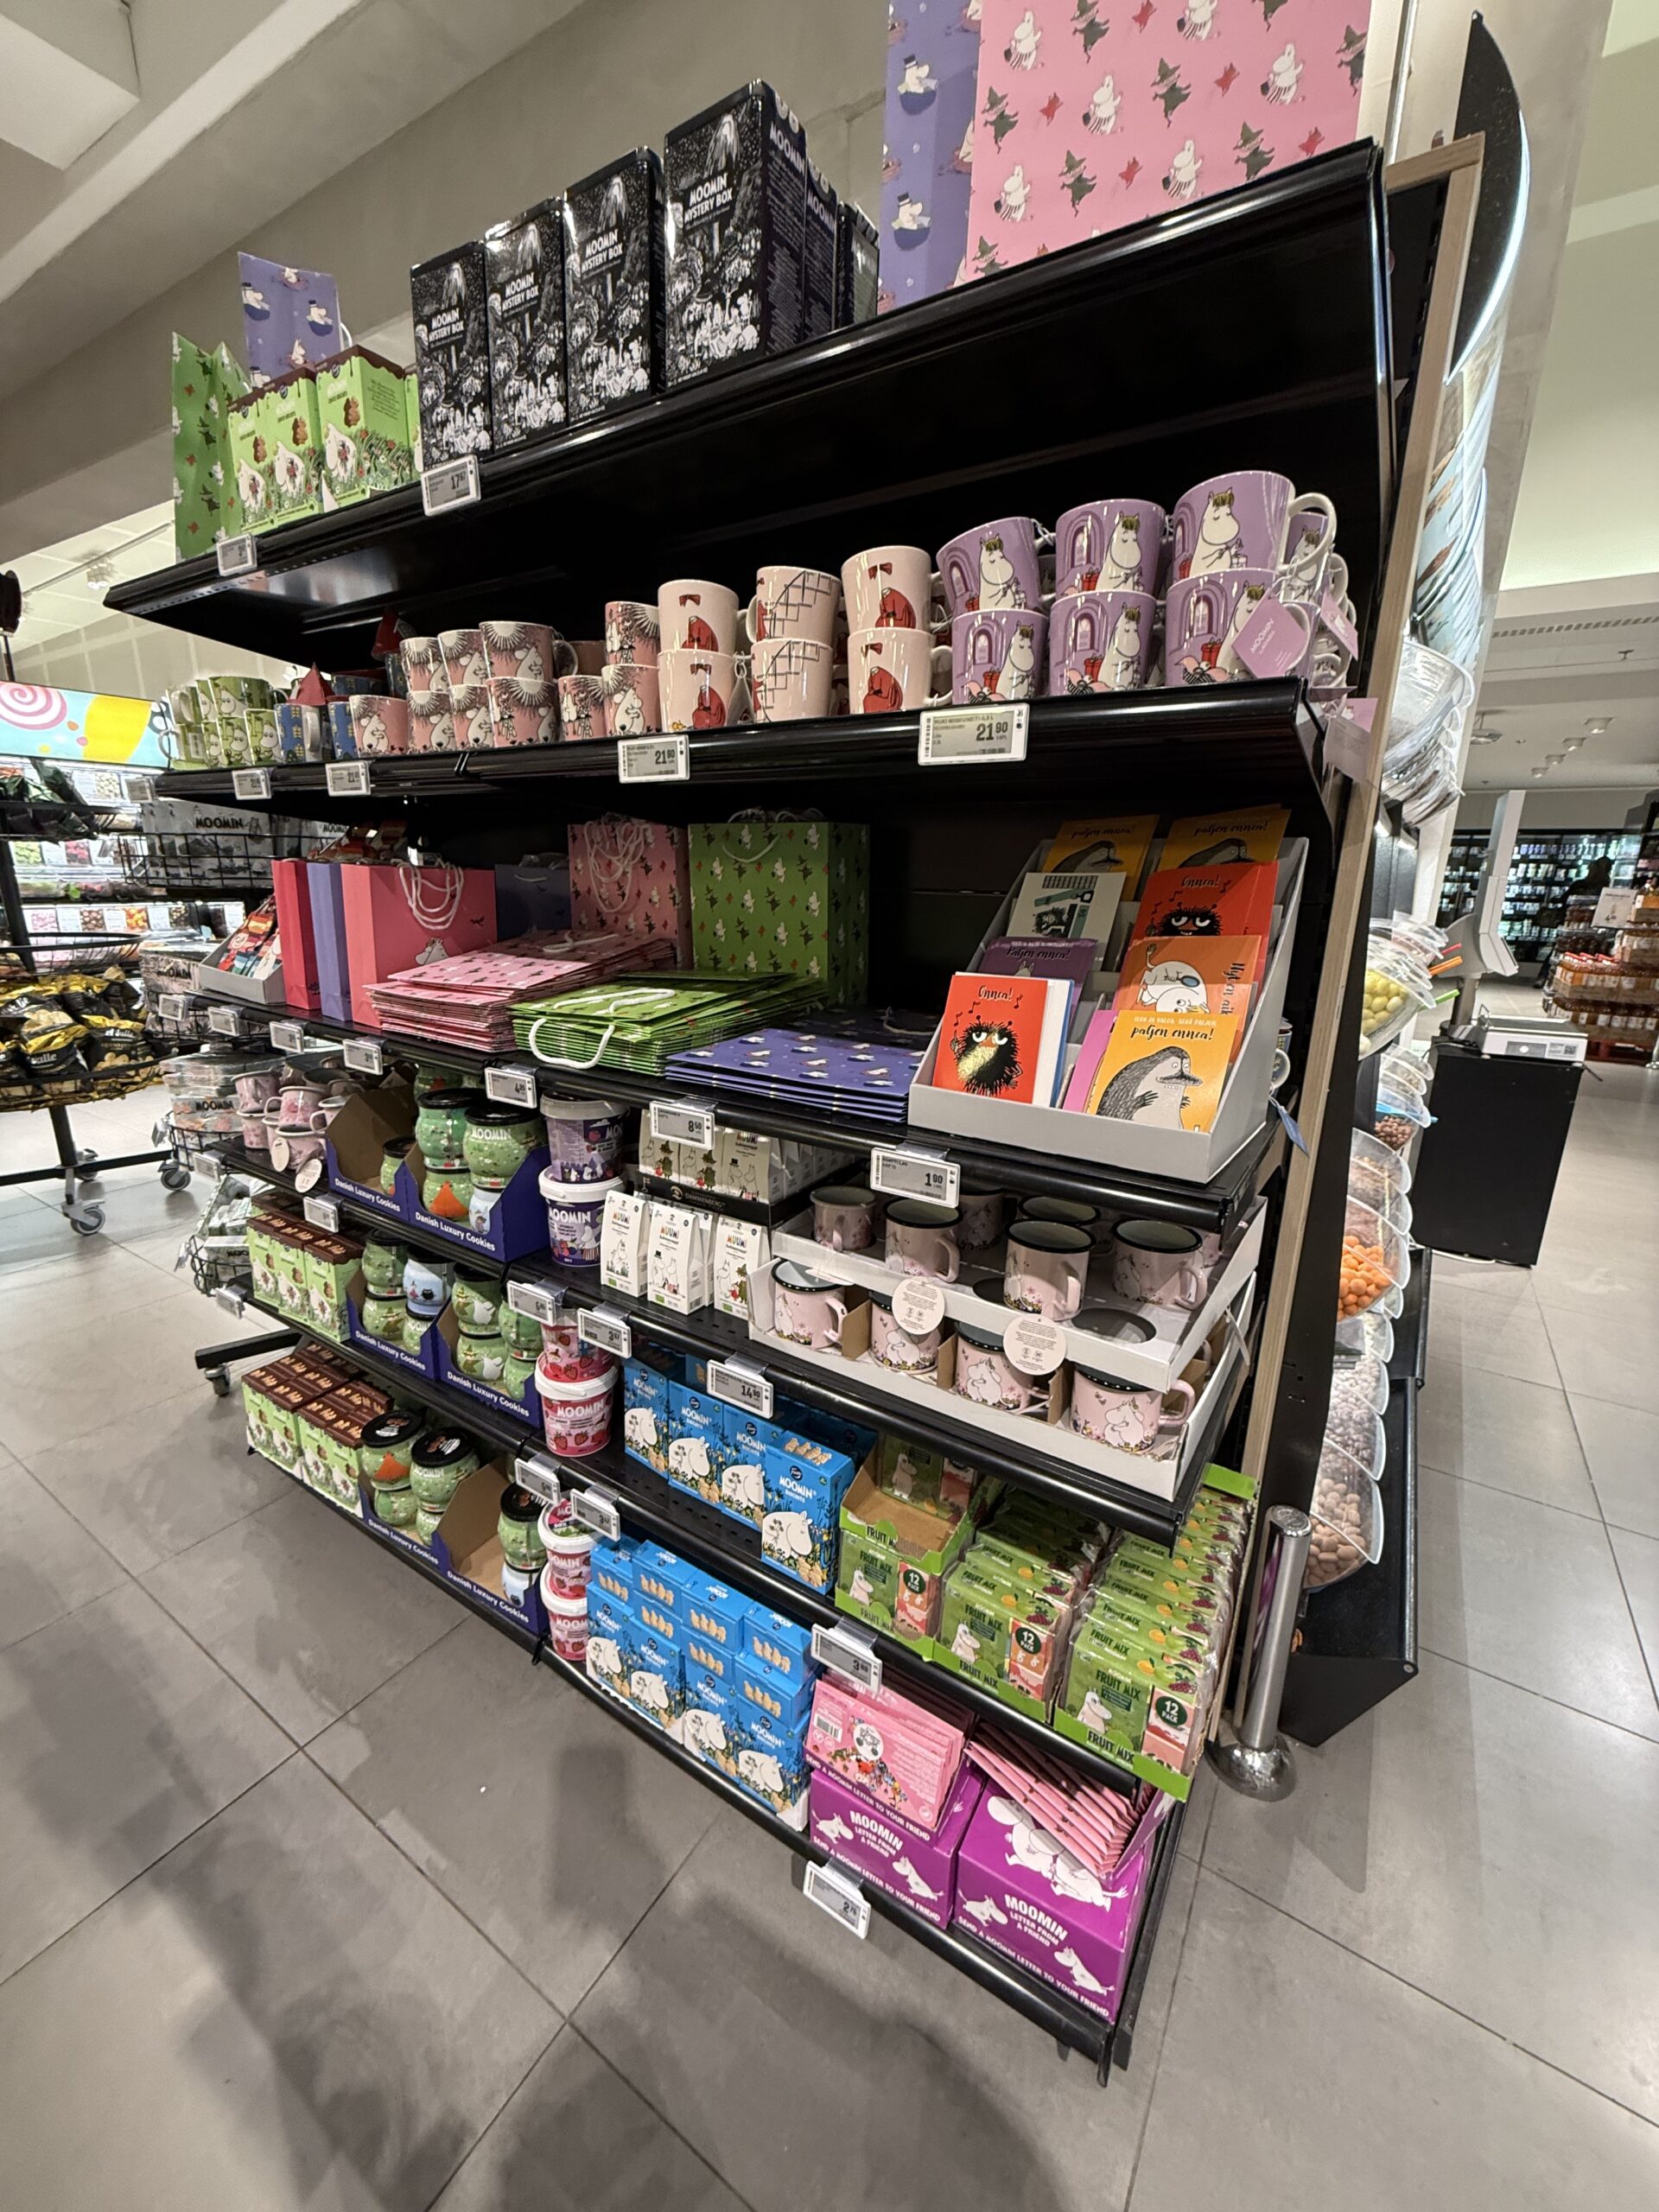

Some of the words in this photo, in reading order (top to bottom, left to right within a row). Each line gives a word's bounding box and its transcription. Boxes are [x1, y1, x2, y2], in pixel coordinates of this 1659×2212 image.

[769, 121, 805, 177] MOOMIN
[690, 173, 728, 207] MOOMIN
[684, 196, 715, 223] MYSTERY
[716, 188, 733, 207] BOX
[585, 229, 619, 258] MOOMIN
[582, 250, 607, 273] MYSTERY
[608, 243, 623, 259] BOX
[505, 271, 535, 297] MOOMIN
[502, 294, 524, 311] MYSTERY
[526, 284, 538, 299] BOX
[429, 325, 450, 341] MYSTERY
[452, 321, 464, 334] BOX
[432, 308, 460, 330] MOOMIN
[195, 817, 244, 830] MOOMIN
[978, 985, 1013, 1001] Onnea!
[196, 1100, 233, 1110] MOOMIN
[471, 1128, 512, 1141] MOOMIN
[334, 1178, 354, 1192] Danish
[355, 1186, 375, 1203] Luxury
[376, 1195, 401, 1212] Cookies
[416, 1211, 439, 1228] Danish
[440, 1221, 465, 1240] Luxury
[466, 1233, 495, 1251] Cookies
[660, 1225, 679, 1239] MUUMI
[355, 1331, 377, 1347] Danish
[378, 1340, 399, 1358] Luxury
[399, 1351, 426, 1370] Cookies
[447, 1370, 472, 1389] Danish
[473, 1382, 498, 1403] Luxury
[499, 1395, 530, 1417] Cookies
[556, 1399, 604, 1417] MOOMIN
[682, 1406, 709, 1425] MOOMIN
[736, 1432, 766, 1452] MOOMIN
[779, 1475, 813, 1499] MOOMIN
[368, 1519, 390, 1536] Danish
[391, 1529, 412, 1549] Luxury
[413, 1541, 439, 1565] Cookies
[867, 1526, 887, 1543] FRUIT
[860, 1550, 879, 1568] FRUIT
[880, 1561, 893, 1575] MIX
[1120, 1560, 1141, 1572] FRUIT
[1141, 1567, 1156, 1578] MIX
[907, 1582, 920, 1592] PACK
[909, 1573, 920, 1586] 12
[963, 1570, 982, 1585] FRUIT
[982, 1579, 997, 1591] MIX
[447, 1570, 472, 1590] Danish
[473, 1583, 498, 1606] Luxury
[499, 1599, 530, 1623] Cookies
[965, 1604, 987, 1623] FRUIT
[988, 1617, 1003, 1632] MIX
[1020, 1641, 1034, 1652] PACK
[1022, 1631, 1035, 1645] 12
[1090, 1629, 1114, 1645] FRUIT
[1114, 1642, 1130, 1656] MIX
[960, 1660, 982, 1679] FRUIT
[983, 1672, 999, 1688] MIX
[1096, 1669, 1122, 1691] FRUIT
[1123, 1685, 1141, 1701] MIX
[697, 1681, 728, 1706] MOOMIN
[1161, 1711, 1179, 1724] PACK
[1165, 1700, 1179, 1716] 12
[751, 1721, 785, 1747] MOOMIN
[1089, 1731, 1116, 1752] FRUIT
[1116, 1745, 1135, 1763] MIX
[853, 1787, 874, 1806] LETTER
[875, 1802, 886, 1813] TO
[886, 1808, 906, 1827] YOUR
[906, 1821, 931, 1841] FRIEND
[850, 1810, 903, 1851] MOOMIN
[855, 1826, 878, 1844] LETTER
[878, 1839, 897, 1856] FROM
[867, 1840, 890, 1858] FRIEND
[813, 1836, 830, 1852] SEND
[830, 1847, 836, 1856] A
[836, 1852, 861, 1872] MOOMIN
[862, 1869, 885, 1888] LETTER
[885, 1884, 895, 1894] TO
[895, 1890, 915, 1909] YOUR
[916, 1903, 941, 1923] FRIEND
[1005, 1894, 1068, 1942] MOOMIN
[1010, 1911, 1037, 1931] LETTER
[1037, 1926, 1060, 1946] FROM
[1024, 1925, 1052, 1948] FRIEND
[958, 1916, 977, 1933] SEND
[978, 1929, 985, 1938] A
[986, 1935, 1016, 1959] MOOMIN
[1017, 1954, 1043, 1976] LETTER
[1044, 1972, 1055, 1983] TO
[1056, 1979, 1079, 2000] YOUR
[1080, 1994, 1109, 2018] FRIEND
